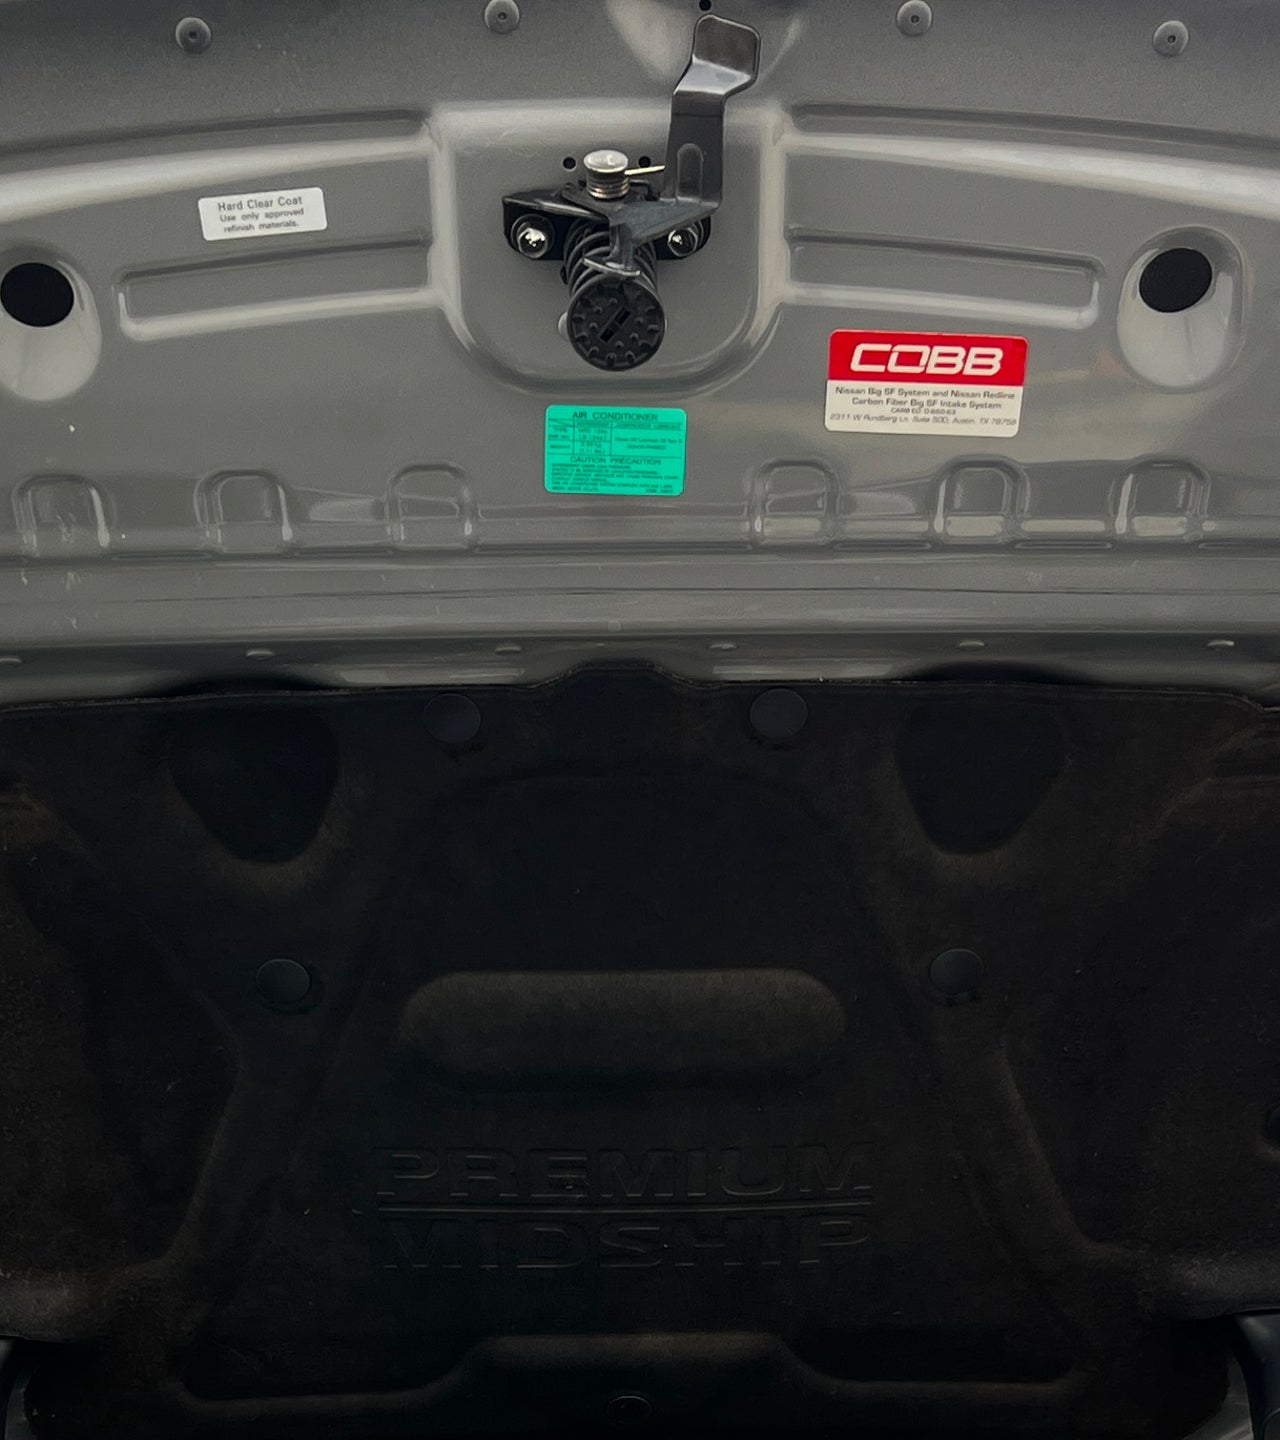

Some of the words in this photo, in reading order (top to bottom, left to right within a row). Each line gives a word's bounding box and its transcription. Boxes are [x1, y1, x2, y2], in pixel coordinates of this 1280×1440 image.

[217, 201, 243, 211] Hard
[247, 199, 273, 209] Clear
[277, 196, 303, 206] Coat
[220, 214, 236, 222] Use
[241, 212, 260, 220] only
[264, 208, 304, 219] approved
[223, 224, 255, 232] refinish
[850, 343, 1004, 376] COBB
[835, 386, 866, 394] Nissan
[868, 387, 882, 396] Big
[897, 388, 930, 397] System
[950, 389, 981, 398] Nissan
[983, 391, 1015, 399] Redline
[852, 397, 884, 405] Carbon
[886, 398, 908, 406] Fiber
[910, 399, 924, 408] Big
[940, 400, 967, 408] Intake
[969, 401, 1002, 410] System
[572, 411, 588, 419] AIR
[592, 411, 658, 421] CONDITIONER
[374, 1143, 875, 1198] PREMIUM
